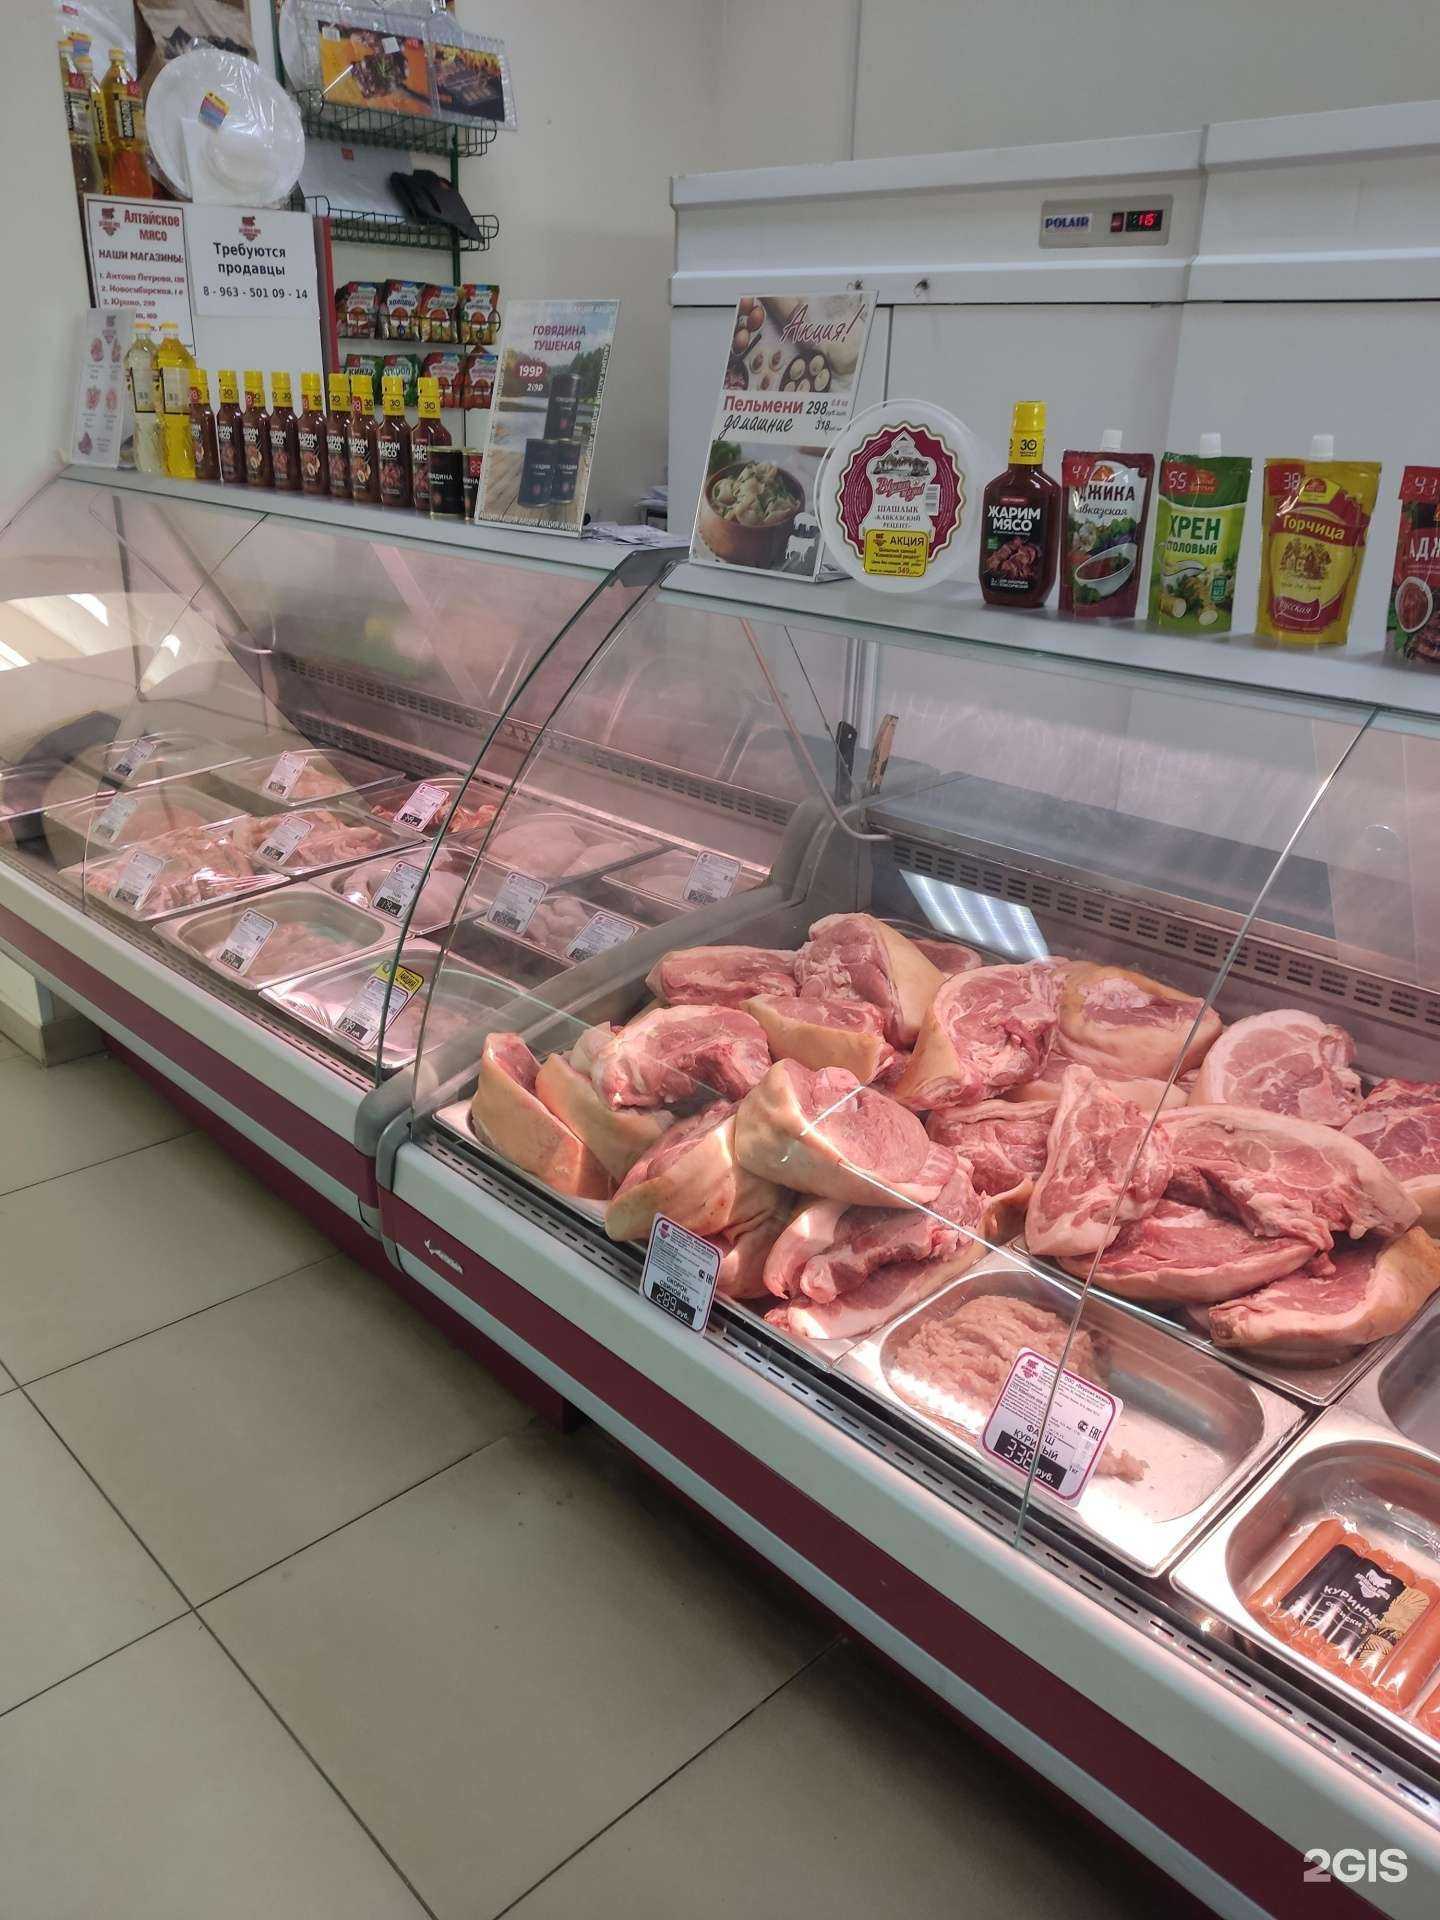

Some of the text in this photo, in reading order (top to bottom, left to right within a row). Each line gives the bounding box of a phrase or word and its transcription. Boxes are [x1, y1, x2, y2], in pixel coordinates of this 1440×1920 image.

[124, 209, 180, 227] Алтайское
[1044, 216, 1090, 228] POLAIR
[98, 249, 184, 264] НАШИ МАГАЗИНЫ:
[213, 243, 286, 259] Требуются
[218, 262, 286, 277] продавцы
[204, 287, 210, 296] 8
[220, 287, 239, 298] 963
[249, 288, 269, 298] 501
[272, 288, 285, 299] 09
[296, 289, 308, 300] 14
[532, 324, 586, 336] ГОВЯДИНА
[778, 304, 865, 344] Акция!
[533, 340, 582, 352] ТУШЕНАЯ
[424, 402, 436, 410] 30
[723, 396, 803, 414] Пельмени
[806, 400, 829, 416] 298
[718, 414, 830, 440] домашние 318
[1020, 439, 1037, 450] 30
[1168, 470, 1188, 490] 55
[1284, 472, 1300, 490] 38
[1414, 478, 1438, 496] 41
[1076, 484, 1136, 503] ДЖИКА
[877, 505, 919, 514] ШАШЛЫК
[988, 504, 1041, 521] ЖАРИМ
[1074, 503, 1128, 519] авказская
[992, 517, 1033, 532] МЯСО
[1168, 515, 1221, 540] ХРЕН
[1283, 515, 1345, 540] Горчица
[890, 536, 924, 548] АКЦИЯ
[656, 1289, 678, 1312] 289
[1026, 1424, 1055, 1446] ФАШ
[1035, 1468, 1054, 1484] руб.
[1323, 1584, 1382, 1628] КУРИНЫЕ
